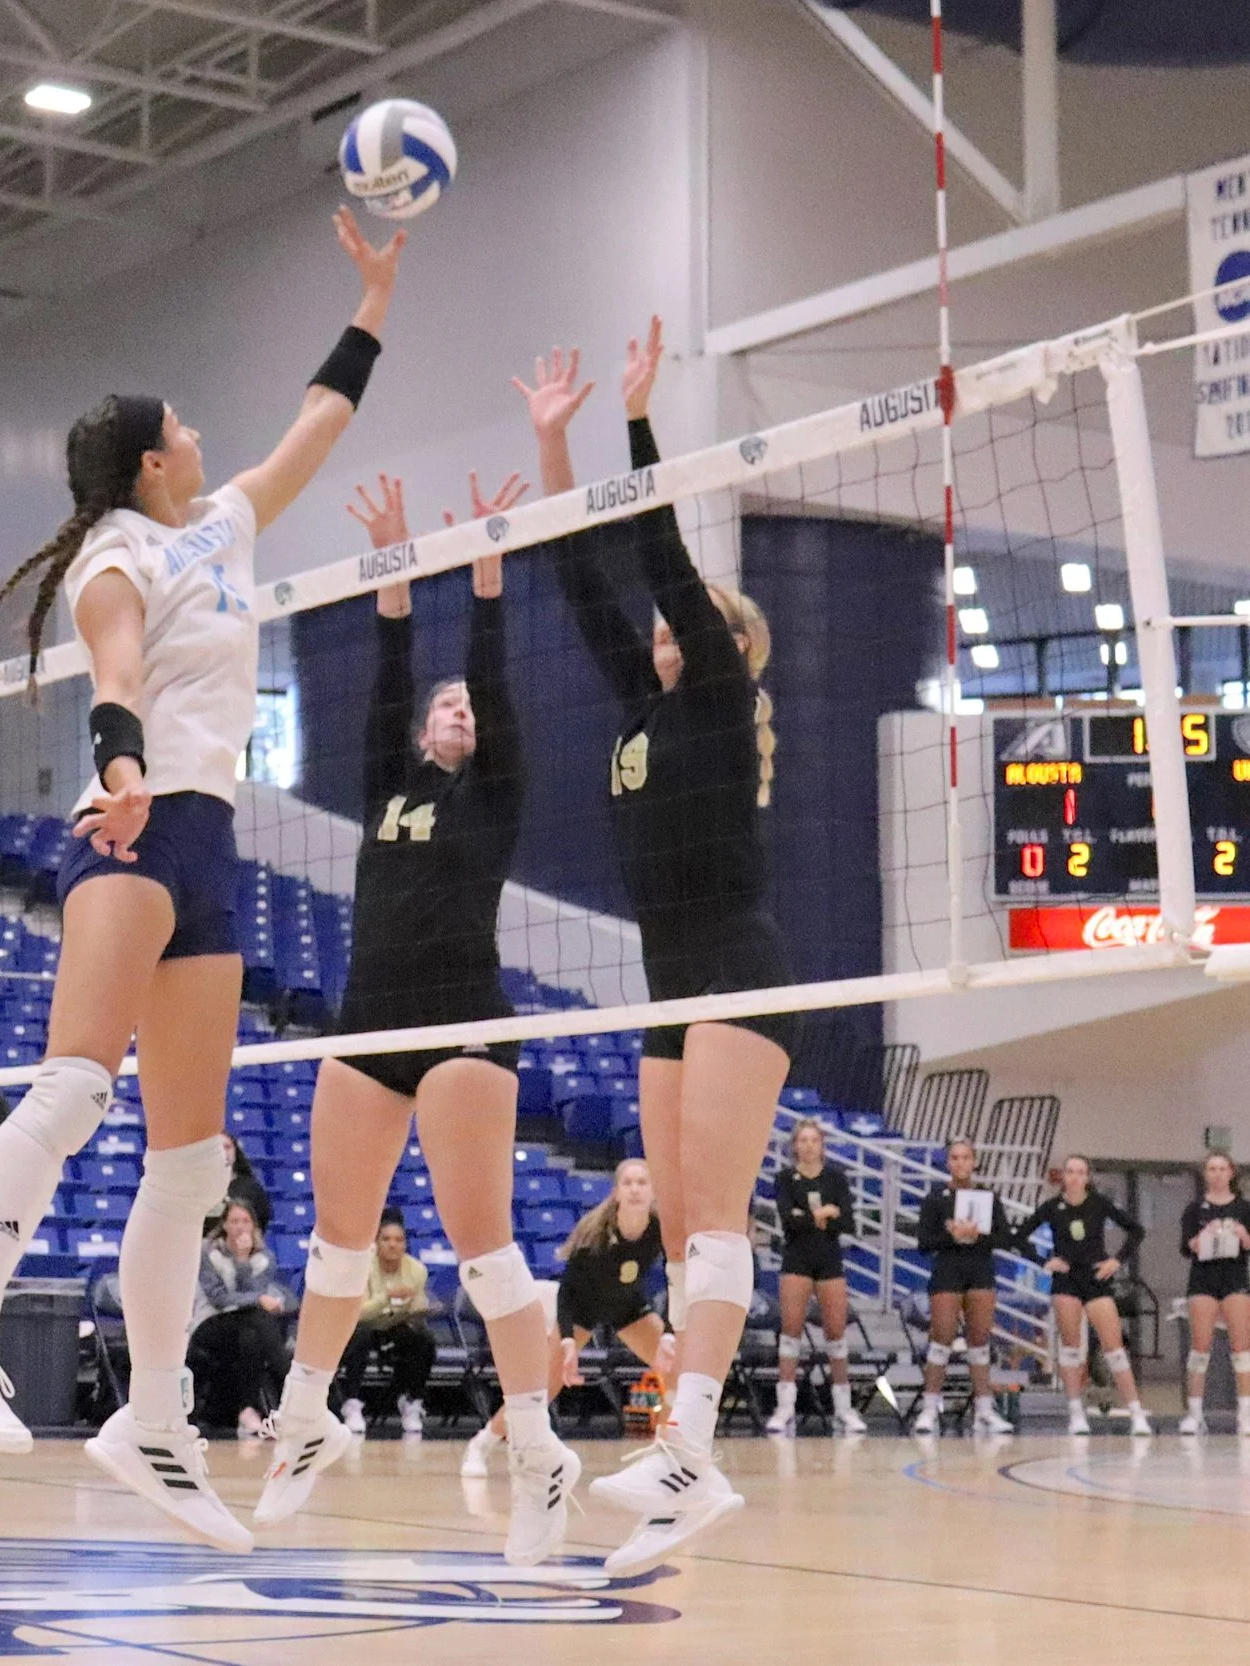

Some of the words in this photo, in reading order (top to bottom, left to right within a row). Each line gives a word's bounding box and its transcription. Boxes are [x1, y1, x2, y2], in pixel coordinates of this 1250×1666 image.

[586, 469, 657, 515] AUGUSTA
[358, 542, 418, 583] AUGUSTA
[611, 732, 649, 796] 19
[1005, 761, 1083, 786] AUGUSTA
[377, 795, 436, 841] 14
[1064, 788, 1077, 826] 1
[1021, 842, 1045, 878] 0
[1067, 842, 1091, 877] 2
[1213, 841, 1236, 876] 2
